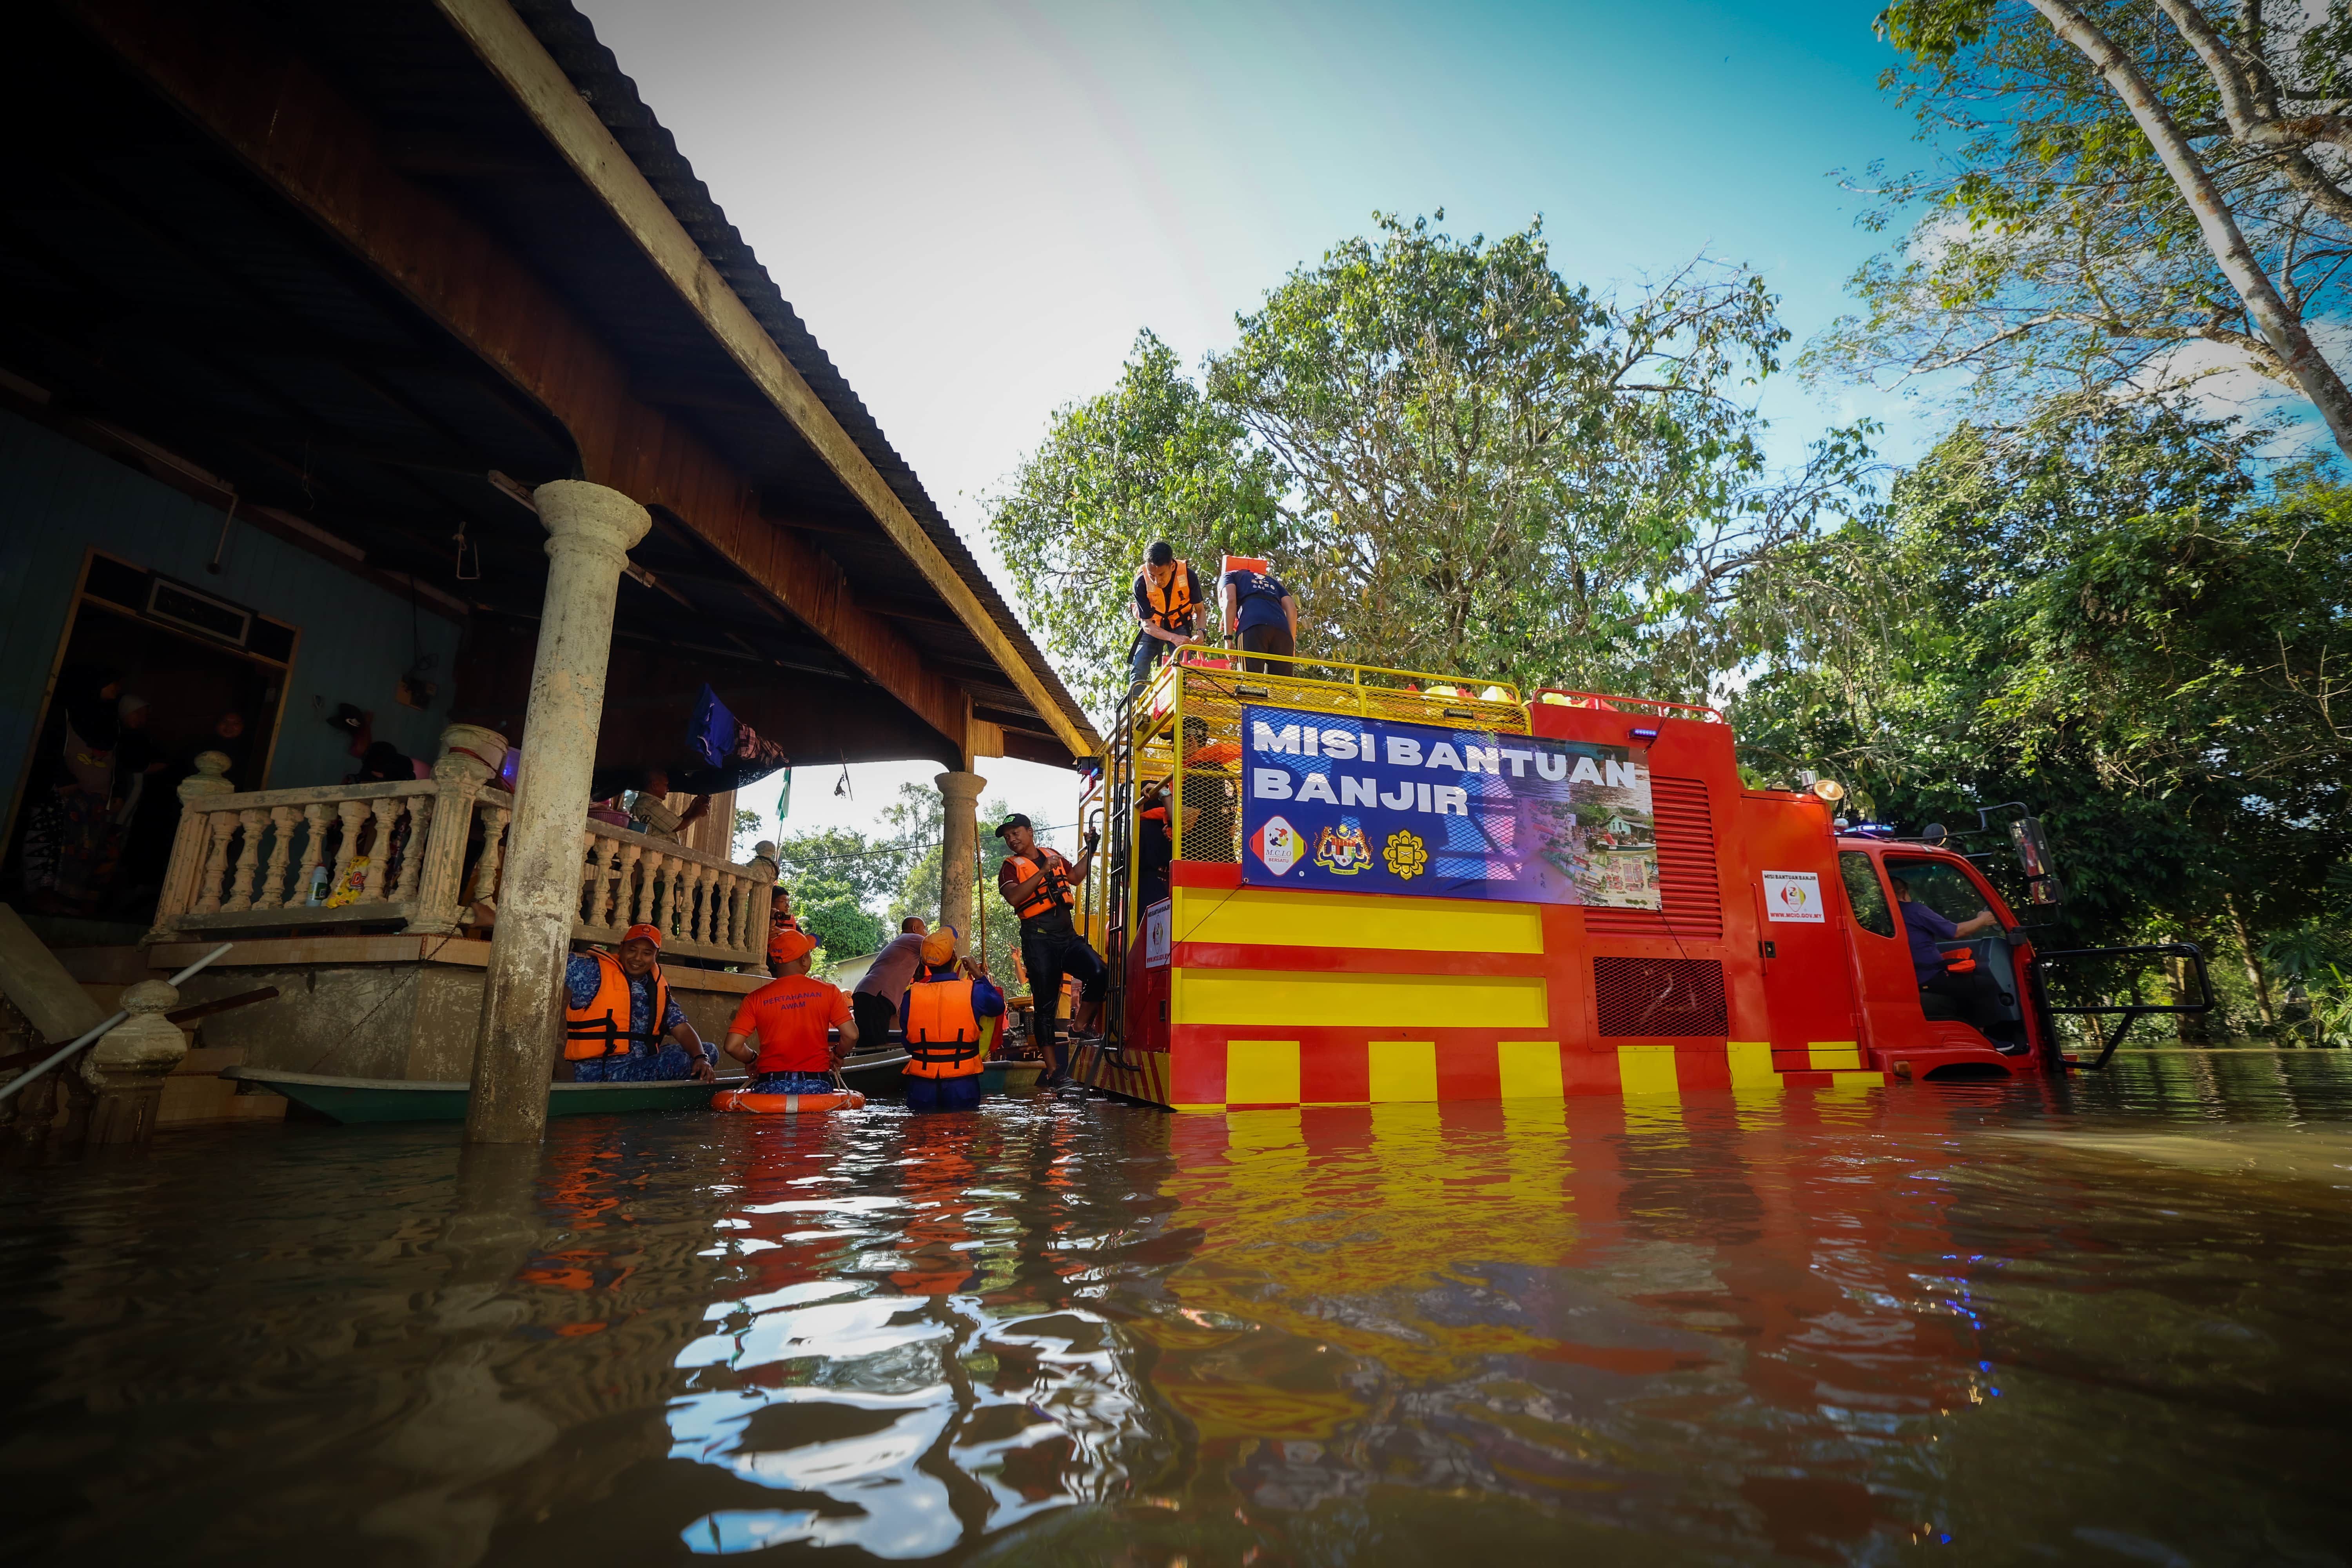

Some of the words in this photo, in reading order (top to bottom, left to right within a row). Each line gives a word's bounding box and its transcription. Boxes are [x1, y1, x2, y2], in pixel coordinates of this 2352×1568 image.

[1253, 721, 1376, 762] MISI
[1386, 735, 1636, 789] BANTUAN
[1254, 767, 1468, 816] BANJIR
[763, 991, 822, 1006] PERTAHANAN
[780, 1000, 806, 1010] AWAM
